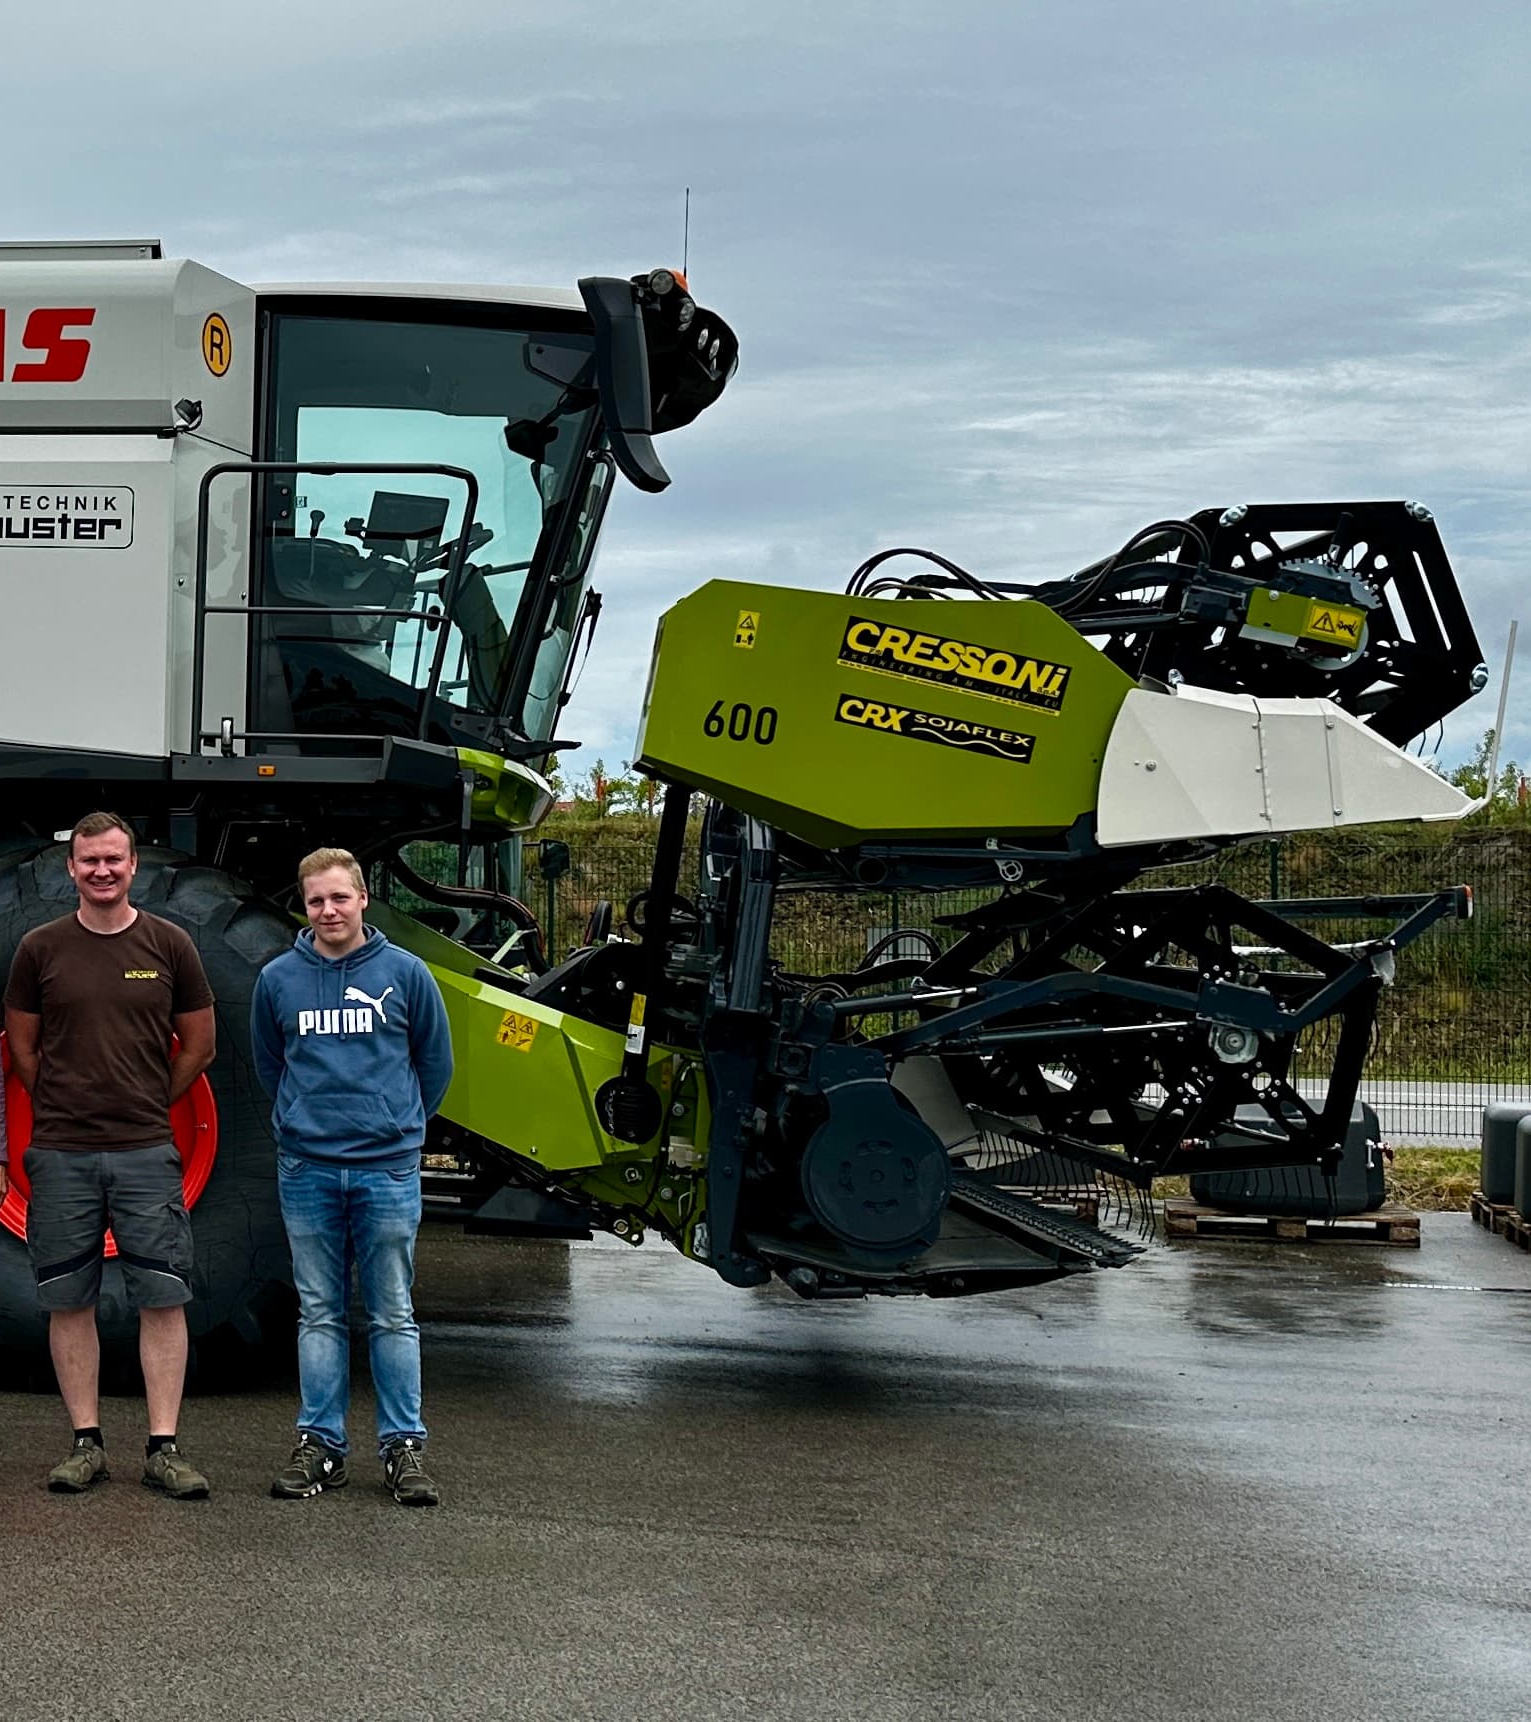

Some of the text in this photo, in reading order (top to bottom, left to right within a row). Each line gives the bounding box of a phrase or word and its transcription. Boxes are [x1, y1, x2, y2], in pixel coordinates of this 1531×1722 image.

[209, 324, 224, 366] R
[703, 700, 778, 746] 600
[839, 699, 1032, 747] CRX SOJAFLEX
[298, 1006, 373, 1036] PUMA
